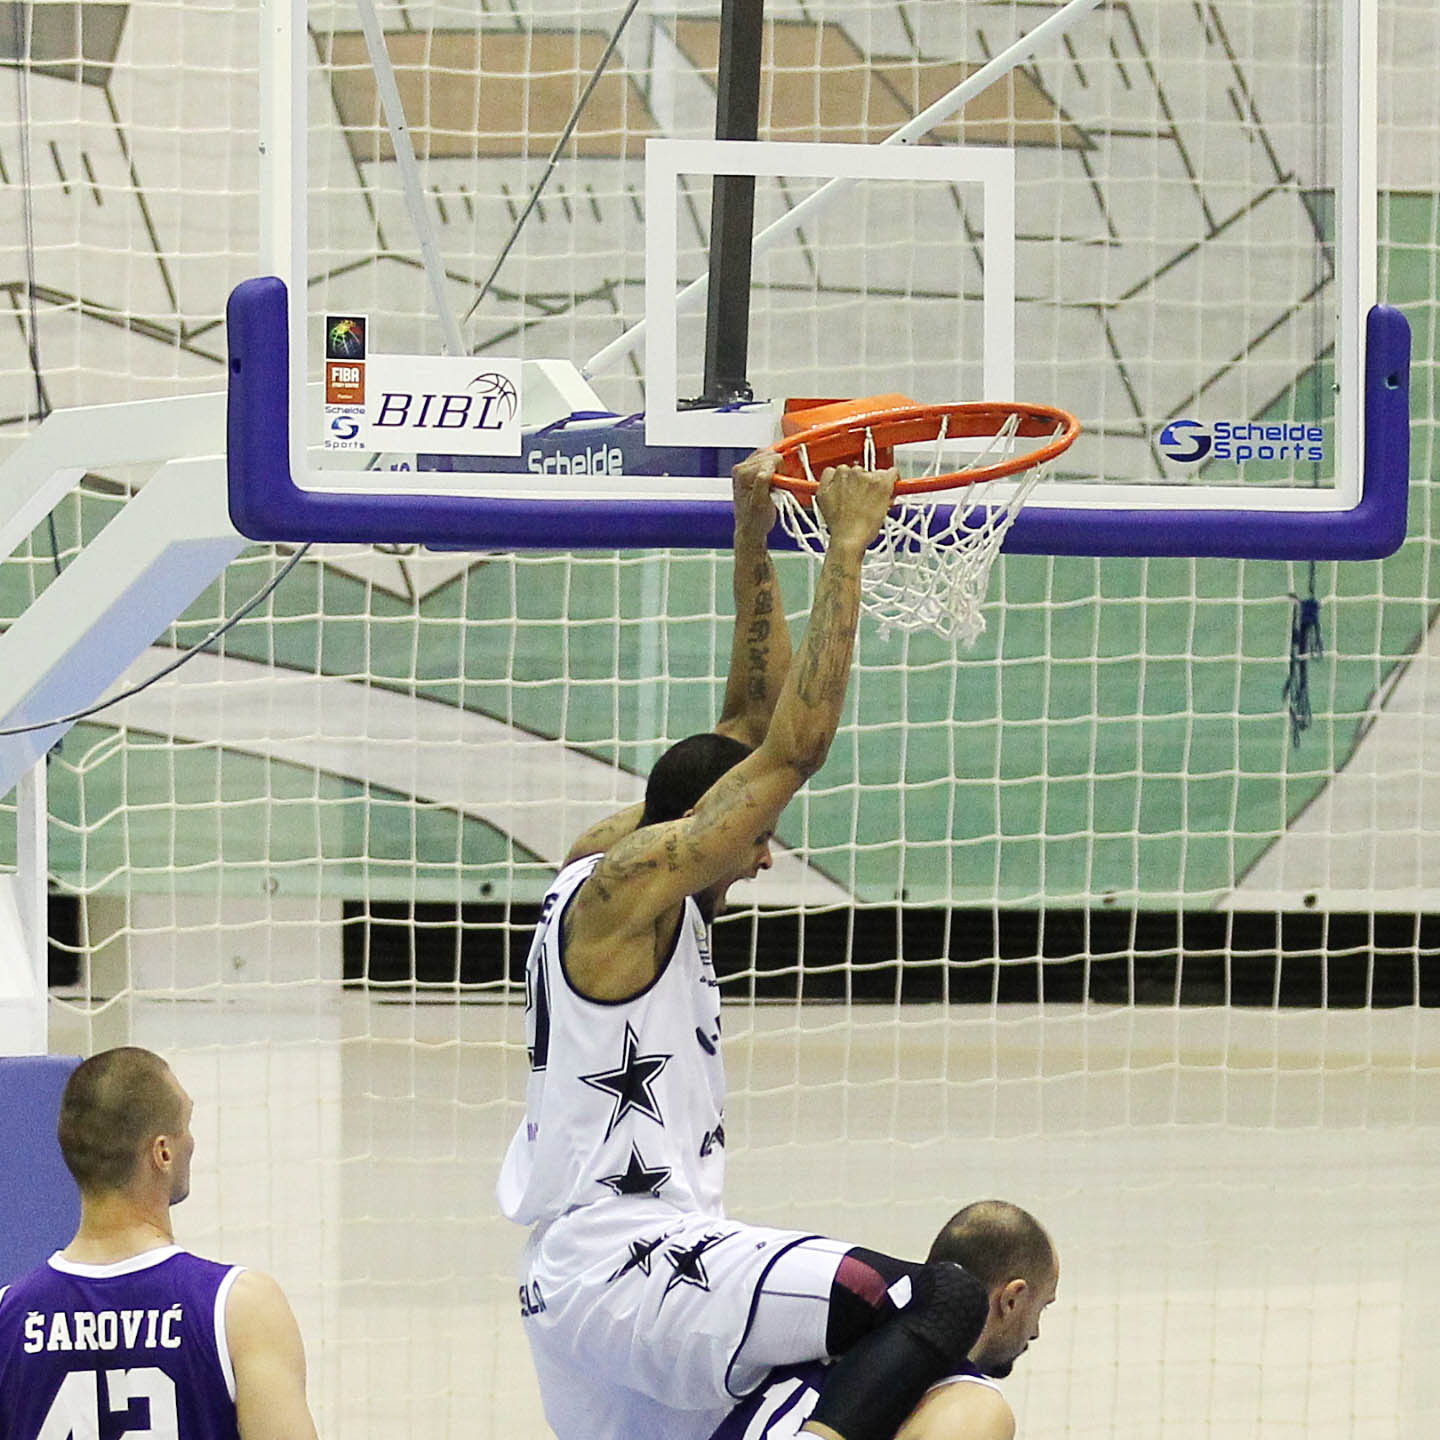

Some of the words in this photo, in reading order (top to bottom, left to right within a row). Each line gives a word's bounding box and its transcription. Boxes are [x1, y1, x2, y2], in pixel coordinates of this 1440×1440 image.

[331, 367, 360, 383] FIBA
[324, 405, 366, 415] Schelde
[372, 392, 504, 431] BIBL
[1214, 421, 1323, 442] Schelde
[324, 439, 366, 450] Sports
[1214, 442, 1323, 464] Sports
[528, 443, 623, 477] Schelde
[23, 1304, 183, 1354] ŠAROVIĆ
